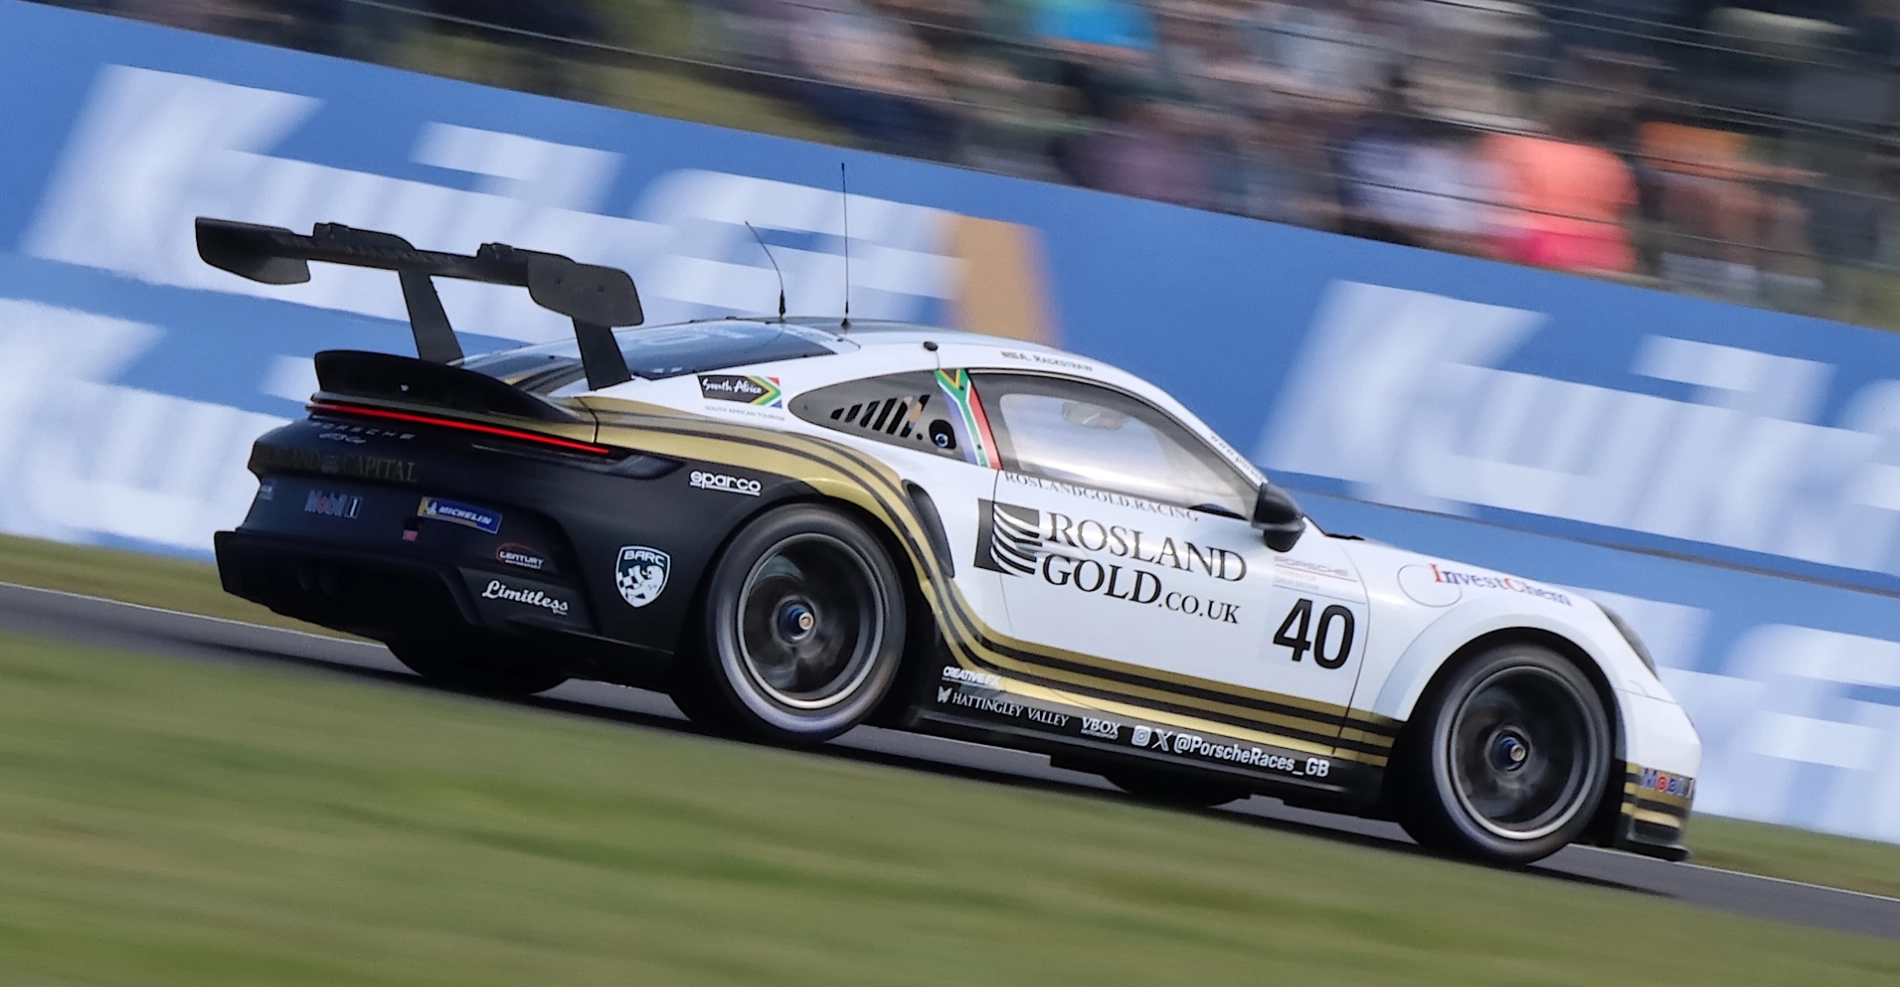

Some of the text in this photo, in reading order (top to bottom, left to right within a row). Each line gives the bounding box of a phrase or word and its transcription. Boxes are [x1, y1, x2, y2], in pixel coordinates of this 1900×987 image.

[702, 378, 762, 395] South Africa
[342, 453, 418, 483] CAPITAL
[304, 489, 347, 518] Mobil
[1004, 472, 1199, 522] ROSLANDGOLD.RACING
[437, 503, 492, 525] MICHELIN
[499, 550, 544, 566] CENTURY
[623, 549, 665, 567] BARC
[1045, 510, 1248, 582] ROSLAND
[481, 579, 569, 611] Limitless
[1042, 554, 1241, 624] GOLD.CO.UK
[1428, 563, 1573, 607] InvestChem
[1272, 597, 1355, 670] 40
[952, 692, 1070, 727] HATTINGLEY VALLEY
[1081, 716, 1121, 735] VBOX
[1173, 733, 1330, 777] @PorscheRaces_GB
